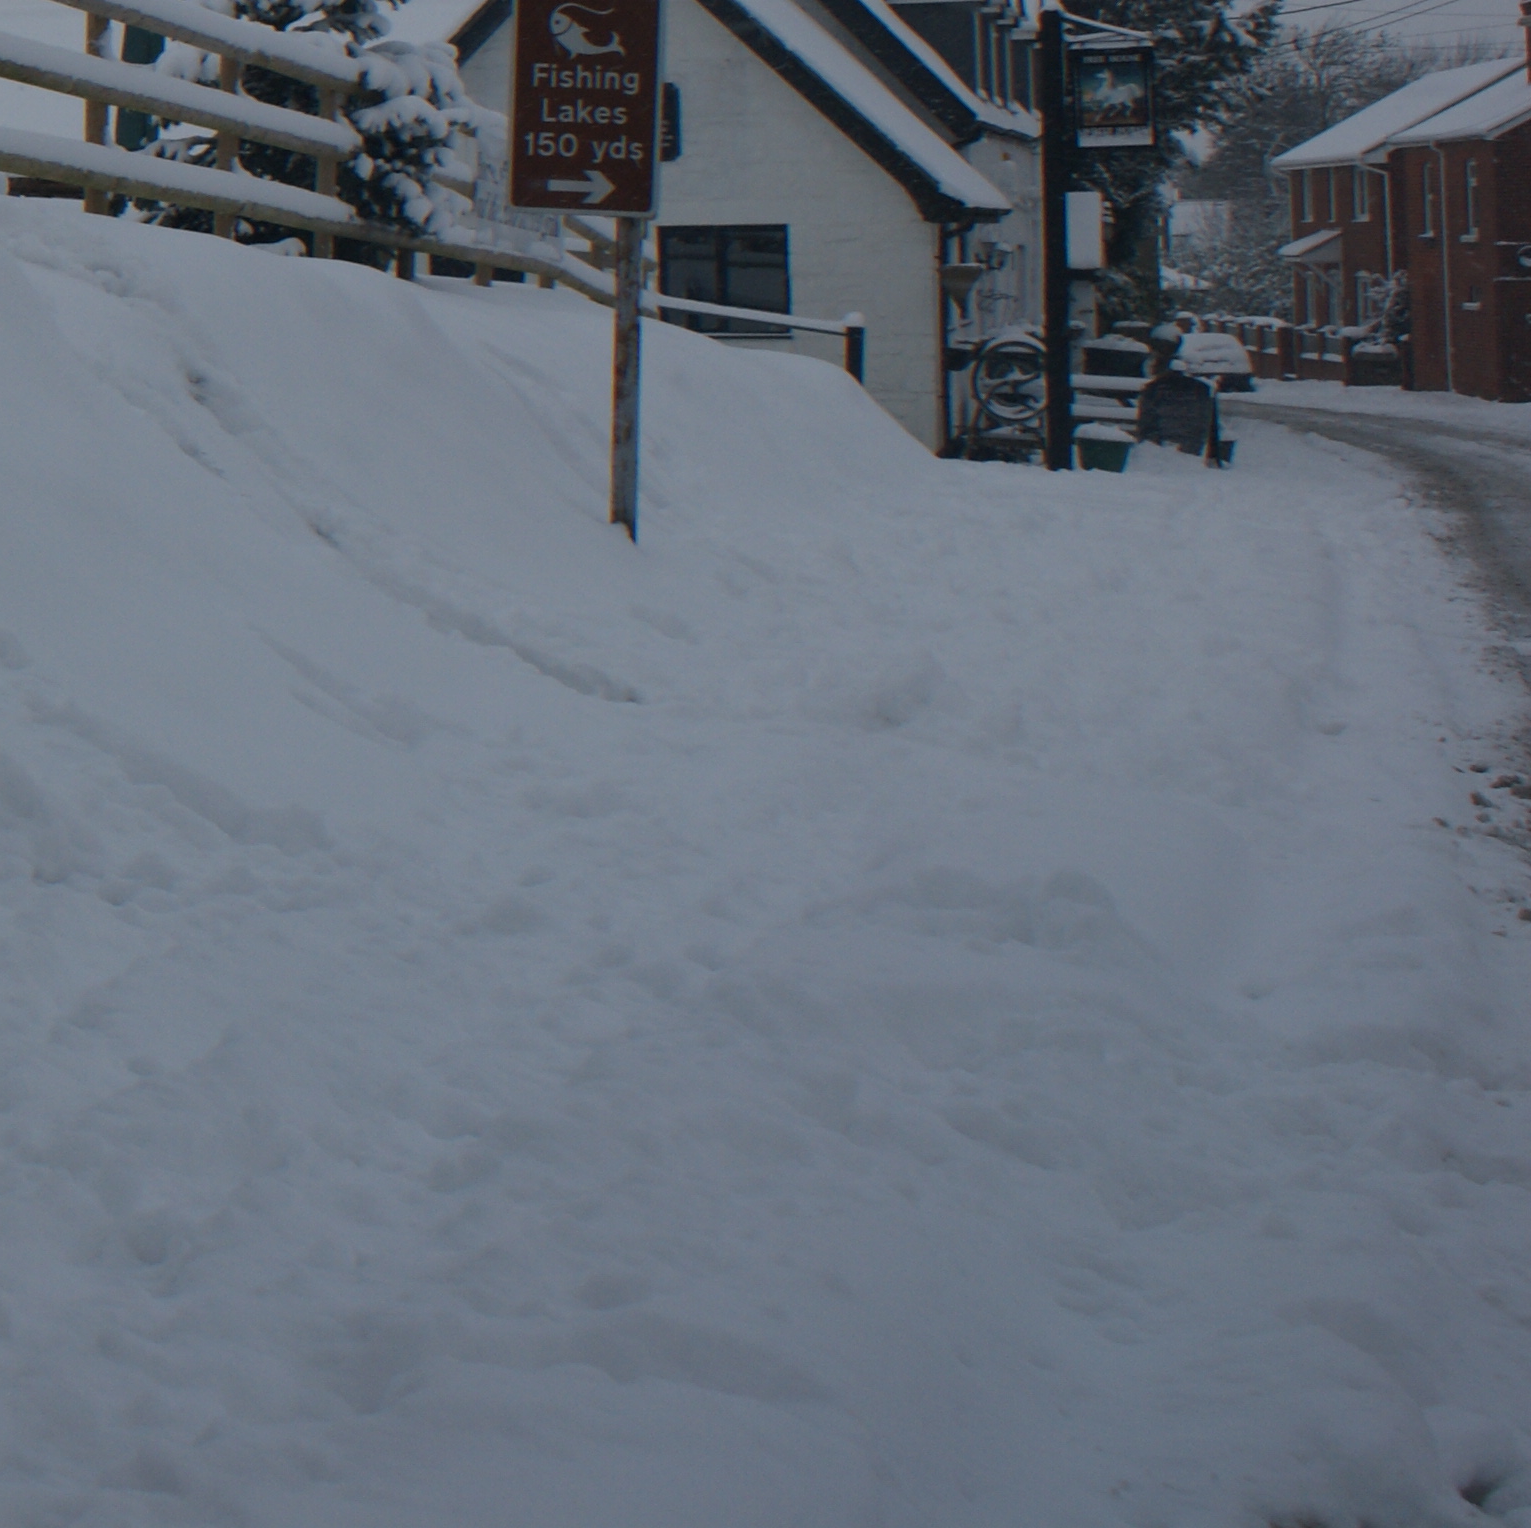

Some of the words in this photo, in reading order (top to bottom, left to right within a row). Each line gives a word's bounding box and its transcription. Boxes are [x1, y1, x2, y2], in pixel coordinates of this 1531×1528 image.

[532, 63, 641, 95] Fishing
[541, 98, 629, 125] Lakes
[524, 132, 579, 157] 150
[590, 135, 644, 164] yds
